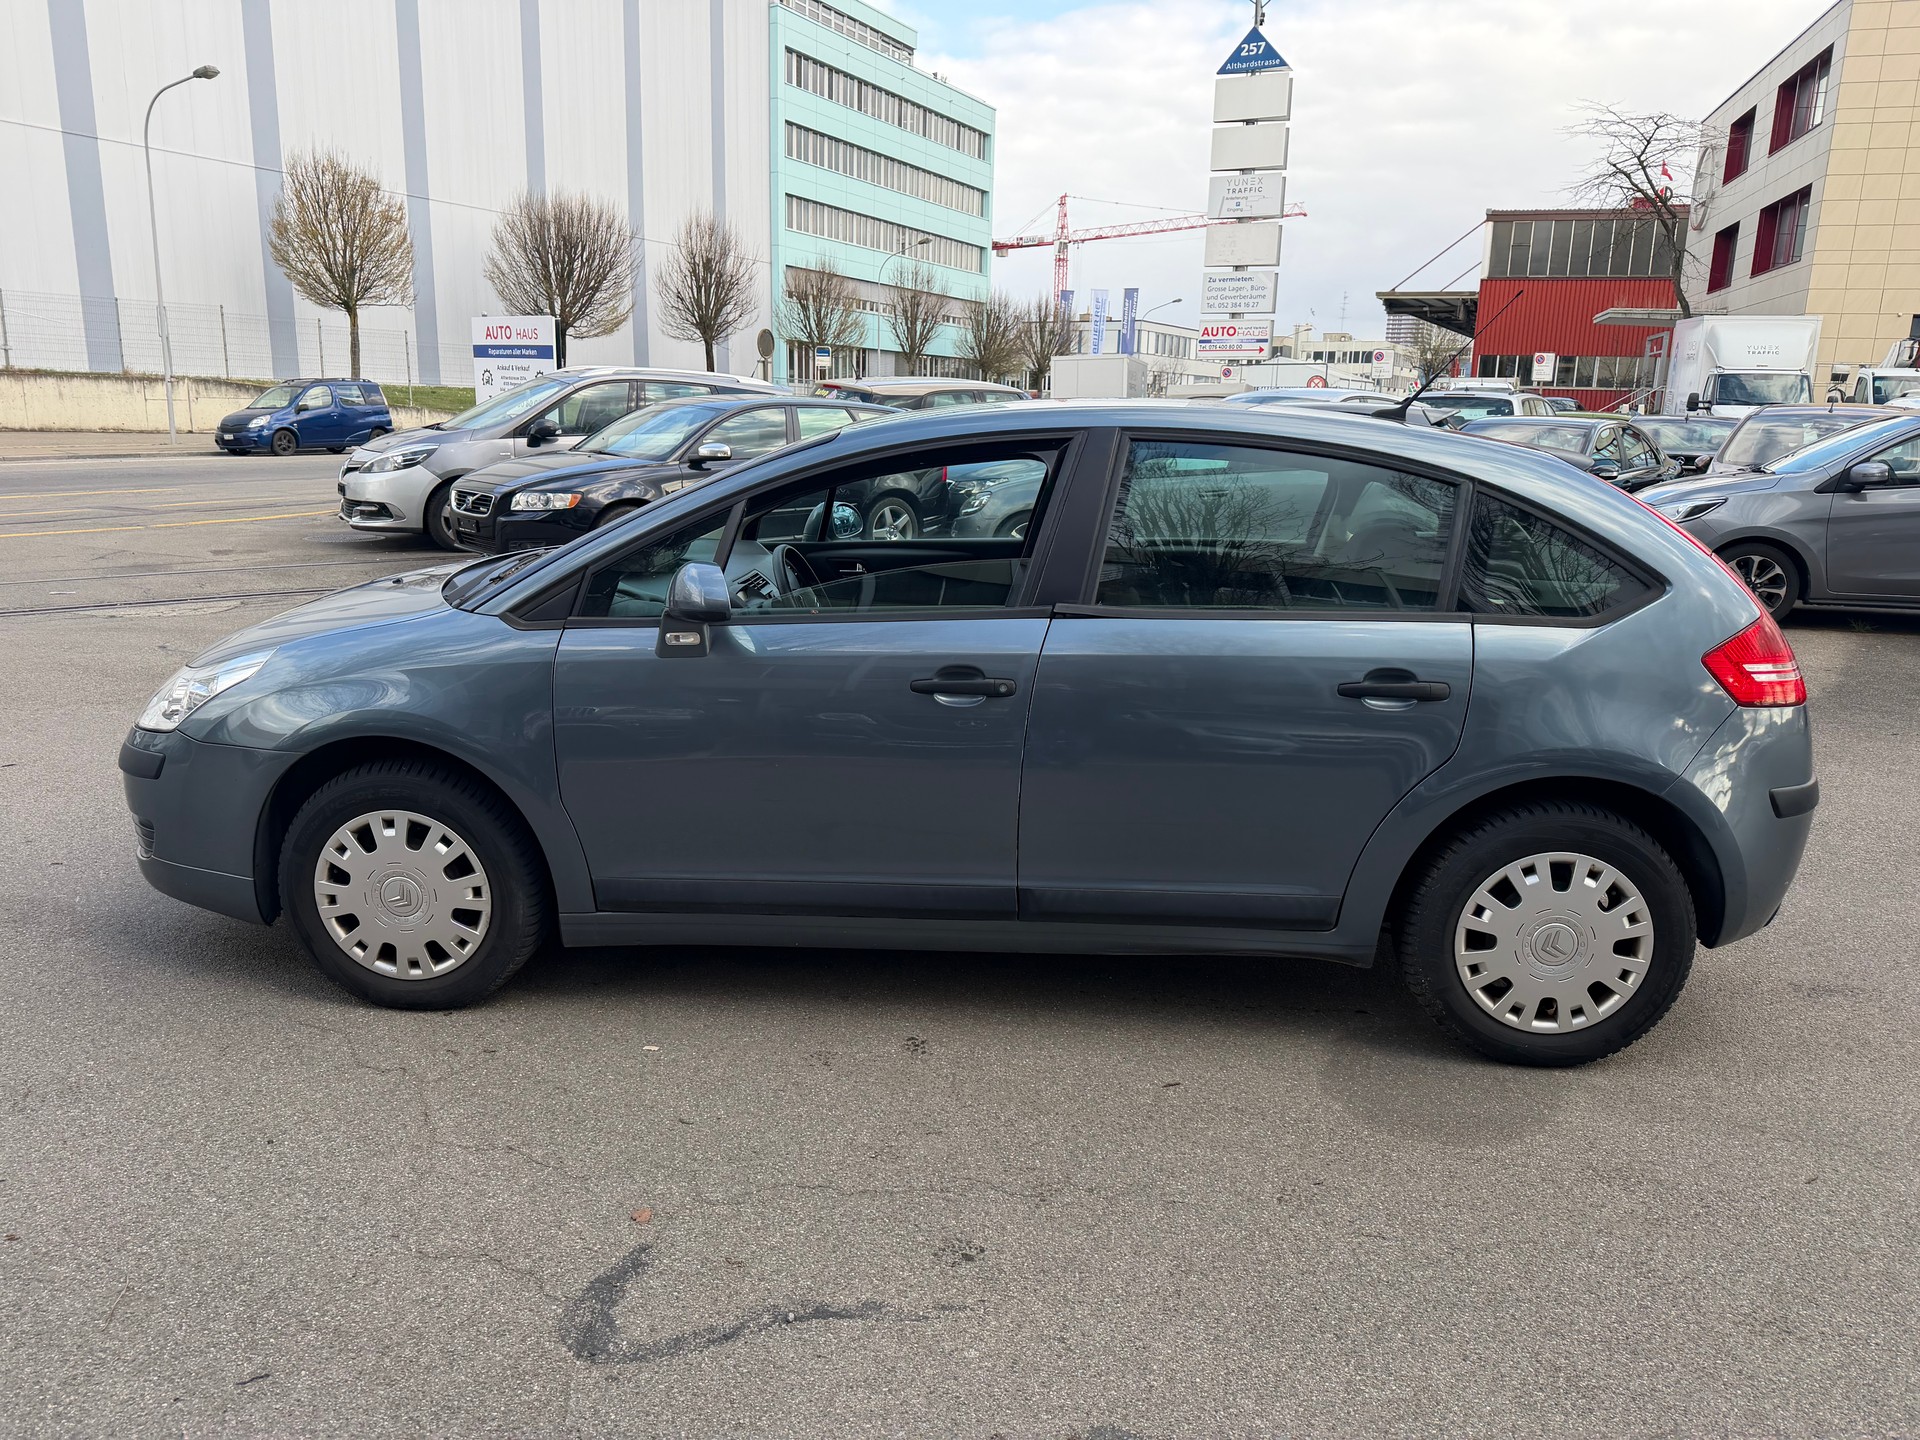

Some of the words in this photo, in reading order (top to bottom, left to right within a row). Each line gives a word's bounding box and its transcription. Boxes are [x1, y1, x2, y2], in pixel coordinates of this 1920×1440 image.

[1240, 41, 1266, 57] 257
[1225, 58, 1281, 70] Althardstrasse
[1226, 176, 1264, 187] YUNEX
[1226, 186, 1264, 194] TRAFFIC
[485, 325, 512, 340] AUTO
[515, 328, 539, 340] HAUS
[1201, 326, 1237, 337] AUTO
[488, 348, 512, 356] Reparaturen
[522, 348, 538, 356] Marken
